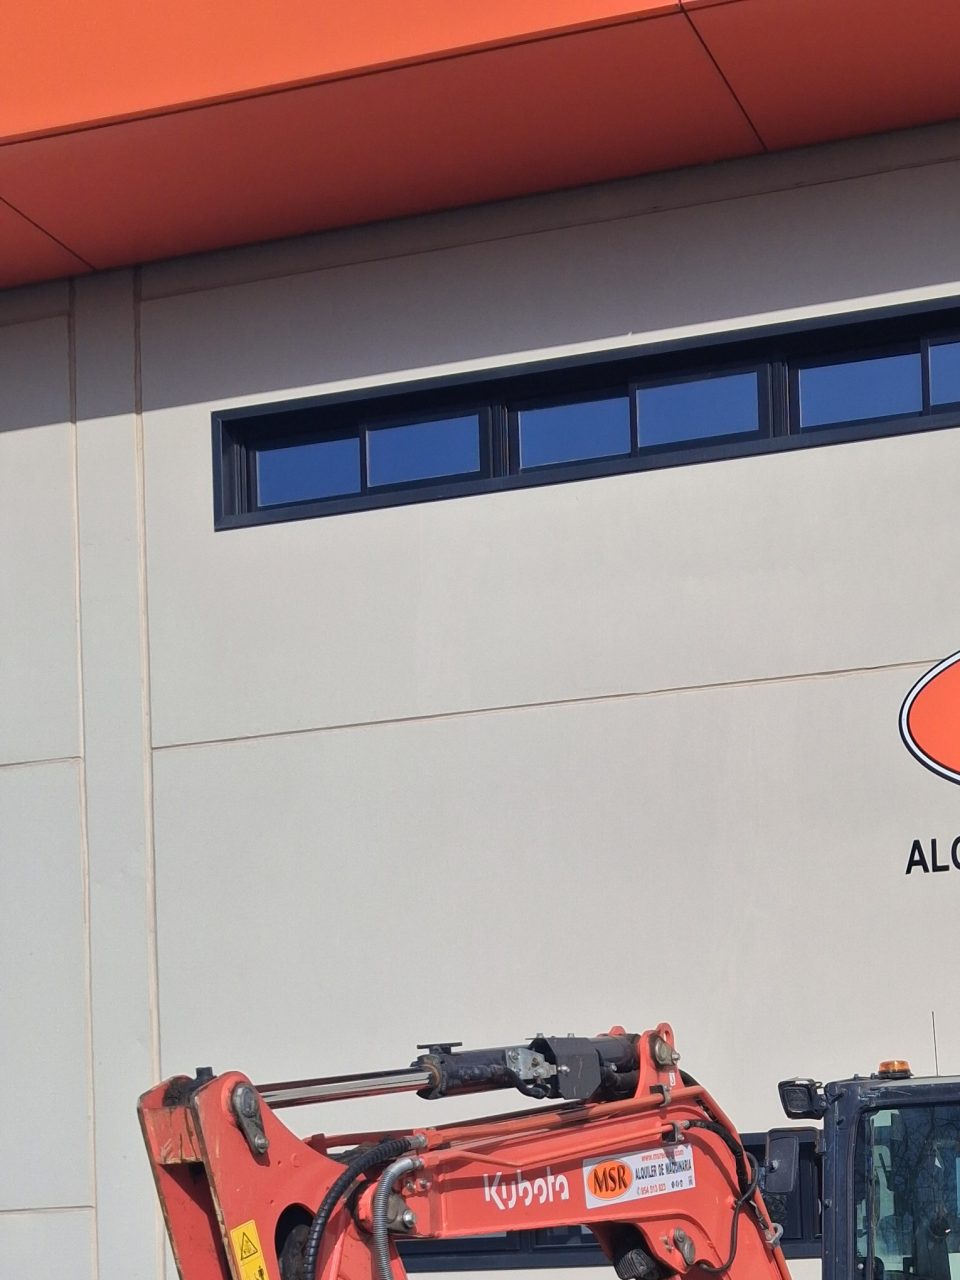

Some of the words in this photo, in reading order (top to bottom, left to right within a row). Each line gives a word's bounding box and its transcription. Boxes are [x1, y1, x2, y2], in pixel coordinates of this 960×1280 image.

[593, 1164, 628, 1195] MSR
[635, 1164, 658, 1180] ALQUILER
[658, 1163, 665, 1176] DE
[665, 1159, 692, 1175] MAQUINARIA
[483, 1166, 570, 1210] Kubota
